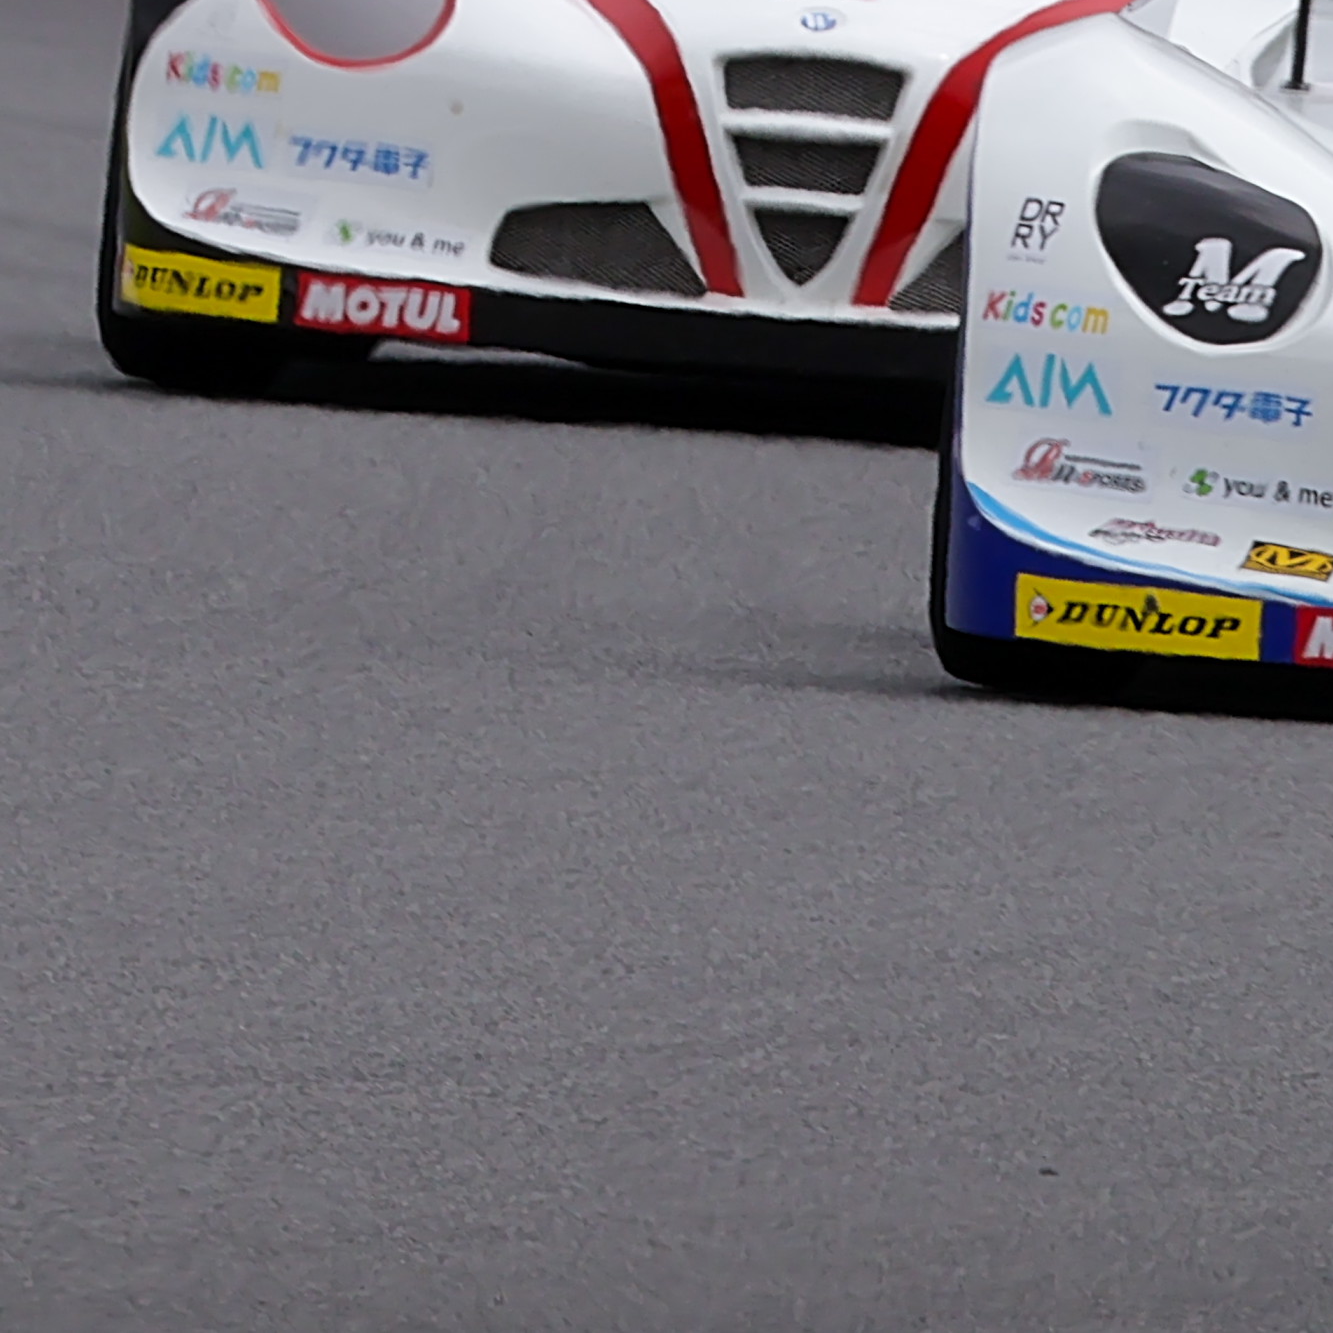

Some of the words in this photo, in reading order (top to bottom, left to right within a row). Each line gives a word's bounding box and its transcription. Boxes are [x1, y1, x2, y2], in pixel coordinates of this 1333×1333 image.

[166, 51, 223, 91] Kids
[156, 114, 264, 170] AIM
[366, 228, 406, 251] you
[410, 232, 427, 251] &
[433, 235, 466, 257] me
[135, 263, 265, 303] DUNLOP
[1178, 277, 1278, 306] Team
[302, 279, 462, 334] MOTUL
[982, 289, 1048, 328] Kids
[1050, 301, 1111, 335] com
[985, 352, 1113, 417] AIM
[1221, 475, 1266, 500] you
[1273, 479, 1290, 503] &
[1058, 601, 1241, 639] DUNLOP
